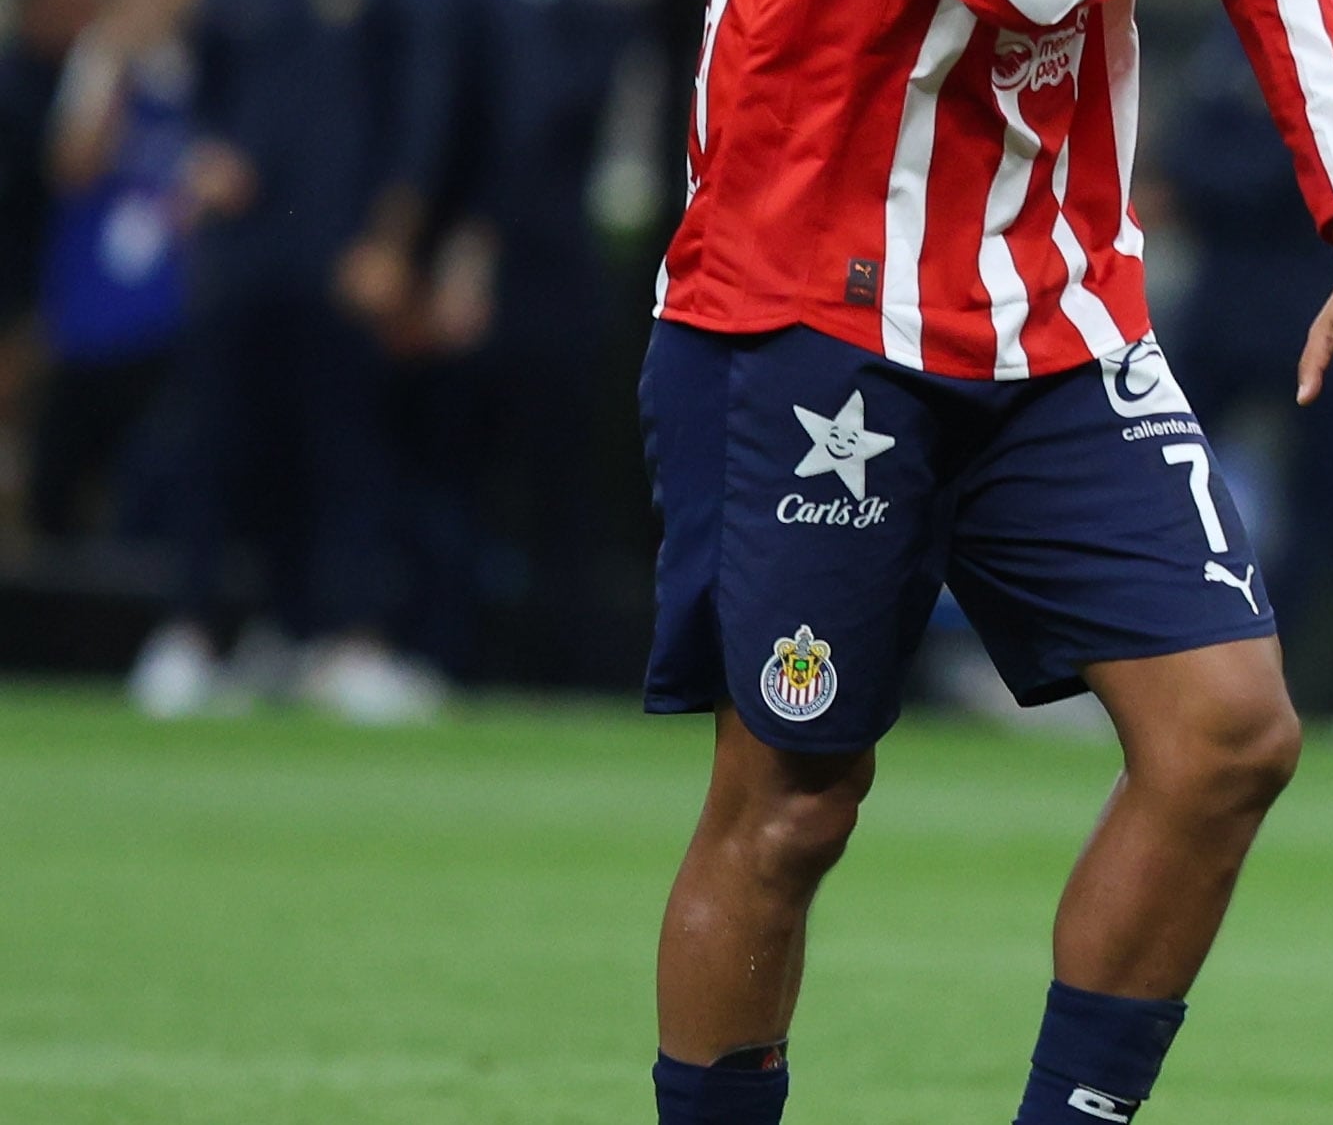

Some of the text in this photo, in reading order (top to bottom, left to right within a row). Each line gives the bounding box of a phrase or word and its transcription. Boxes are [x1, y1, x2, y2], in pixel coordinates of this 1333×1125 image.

[1122, 419, 1202, 441] caliente.m
[777, 493, 889, 528] Carl's Jr.
[1162, 443, 1227, 554] 7
